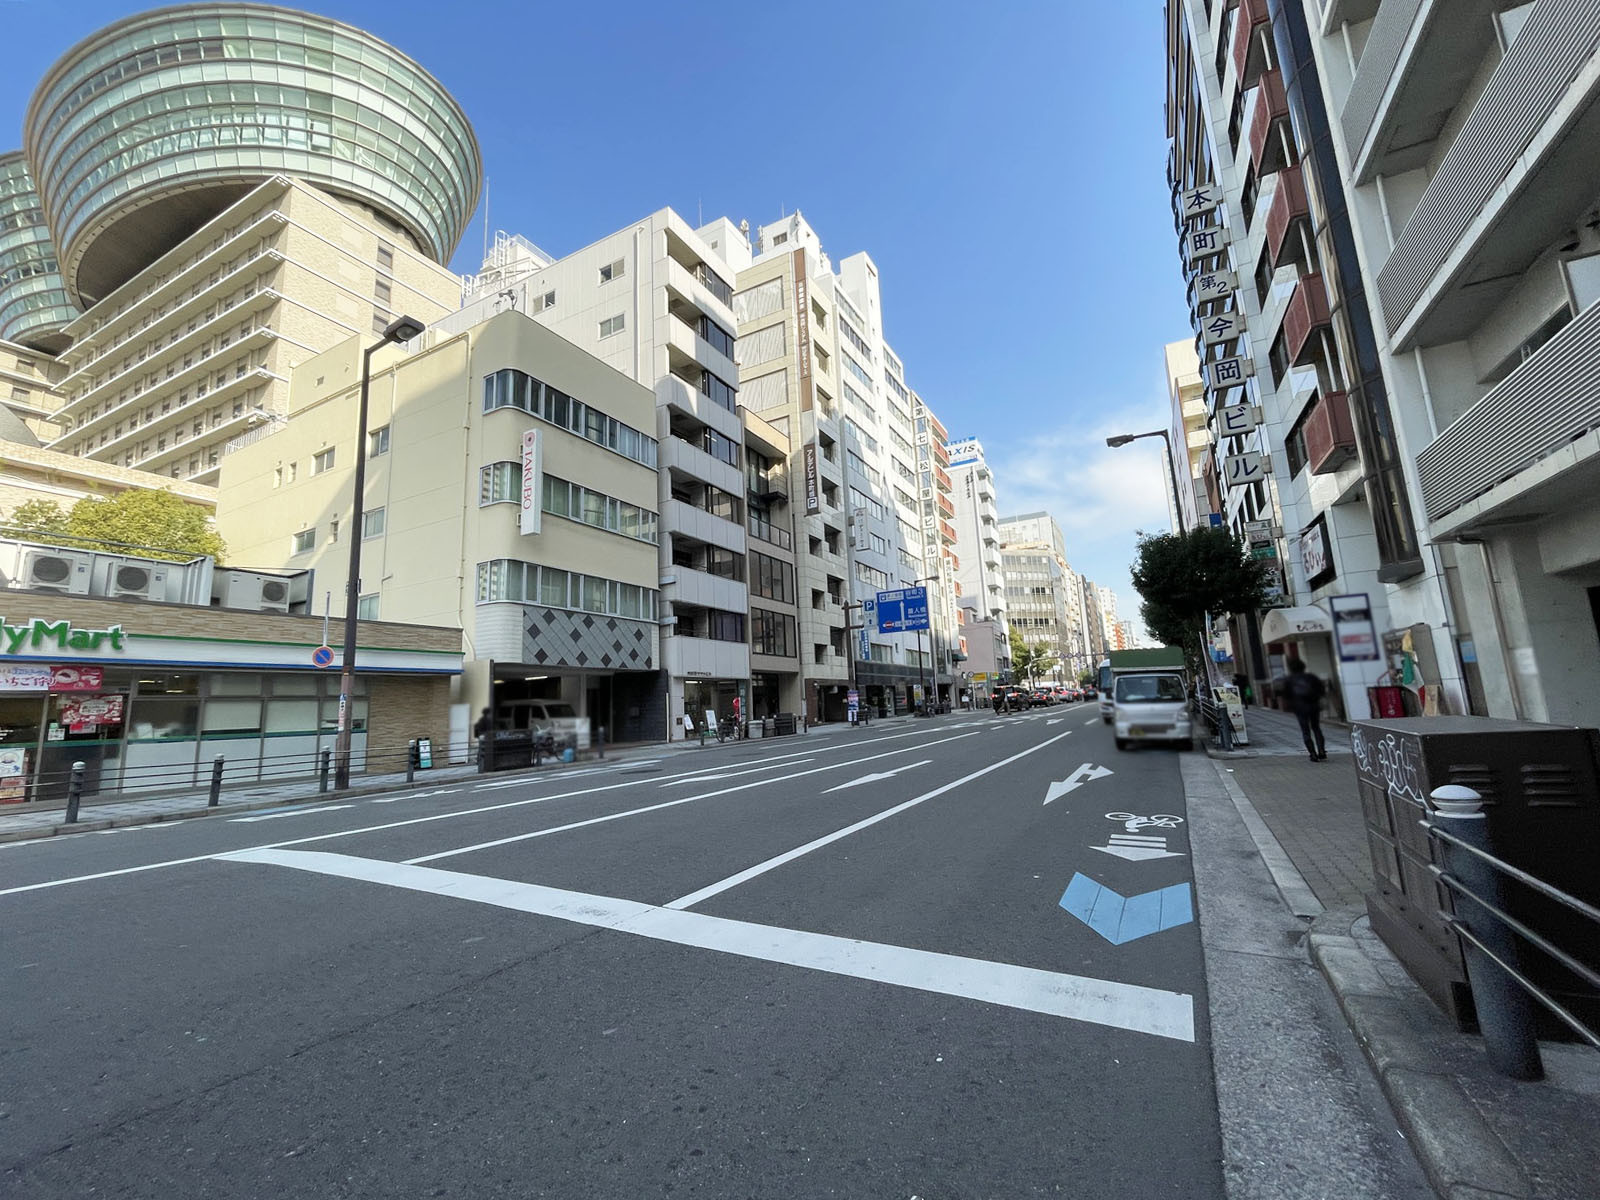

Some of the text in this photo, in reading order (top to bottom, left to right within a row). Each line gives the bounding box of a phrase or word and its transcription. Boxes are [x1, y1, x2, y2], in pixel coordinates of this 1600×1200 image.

[1186, 189, 1258, 480] 本町第2今岡ビル
[523, 450, 533, 510] TAKUBO
